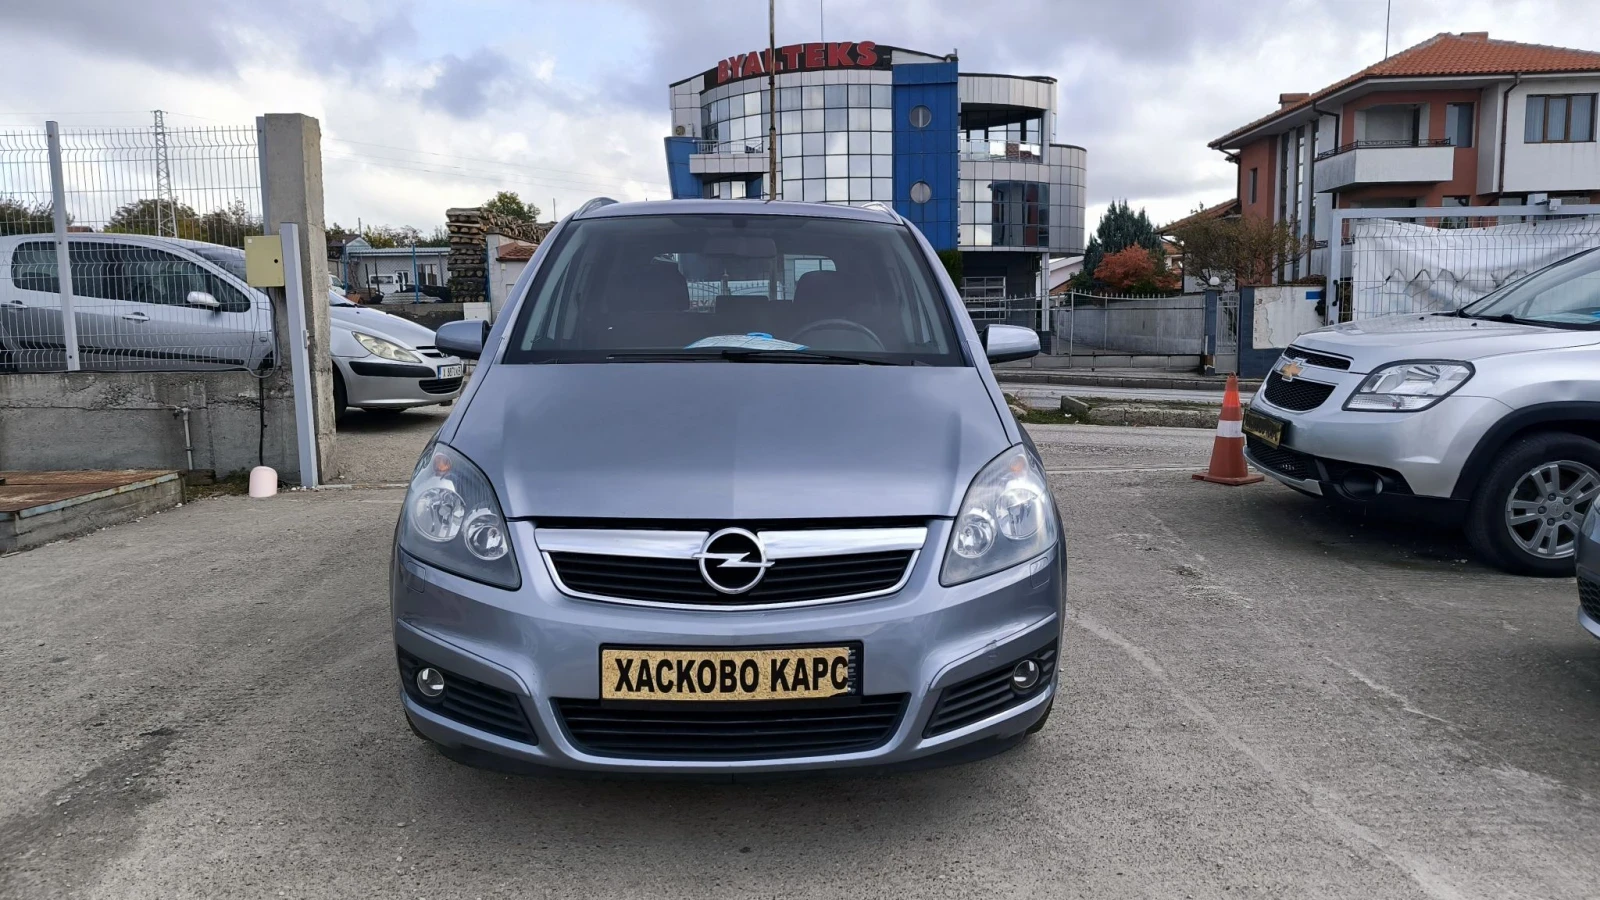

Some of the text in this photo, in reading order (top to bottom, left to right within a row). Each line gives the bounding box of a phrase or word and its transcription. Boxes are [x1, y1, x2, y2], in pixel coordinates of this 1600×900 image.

[718, 41, 878, 83] BYALTEKS
[614, 655, 849, 694] ХАСКОВО КАРС
